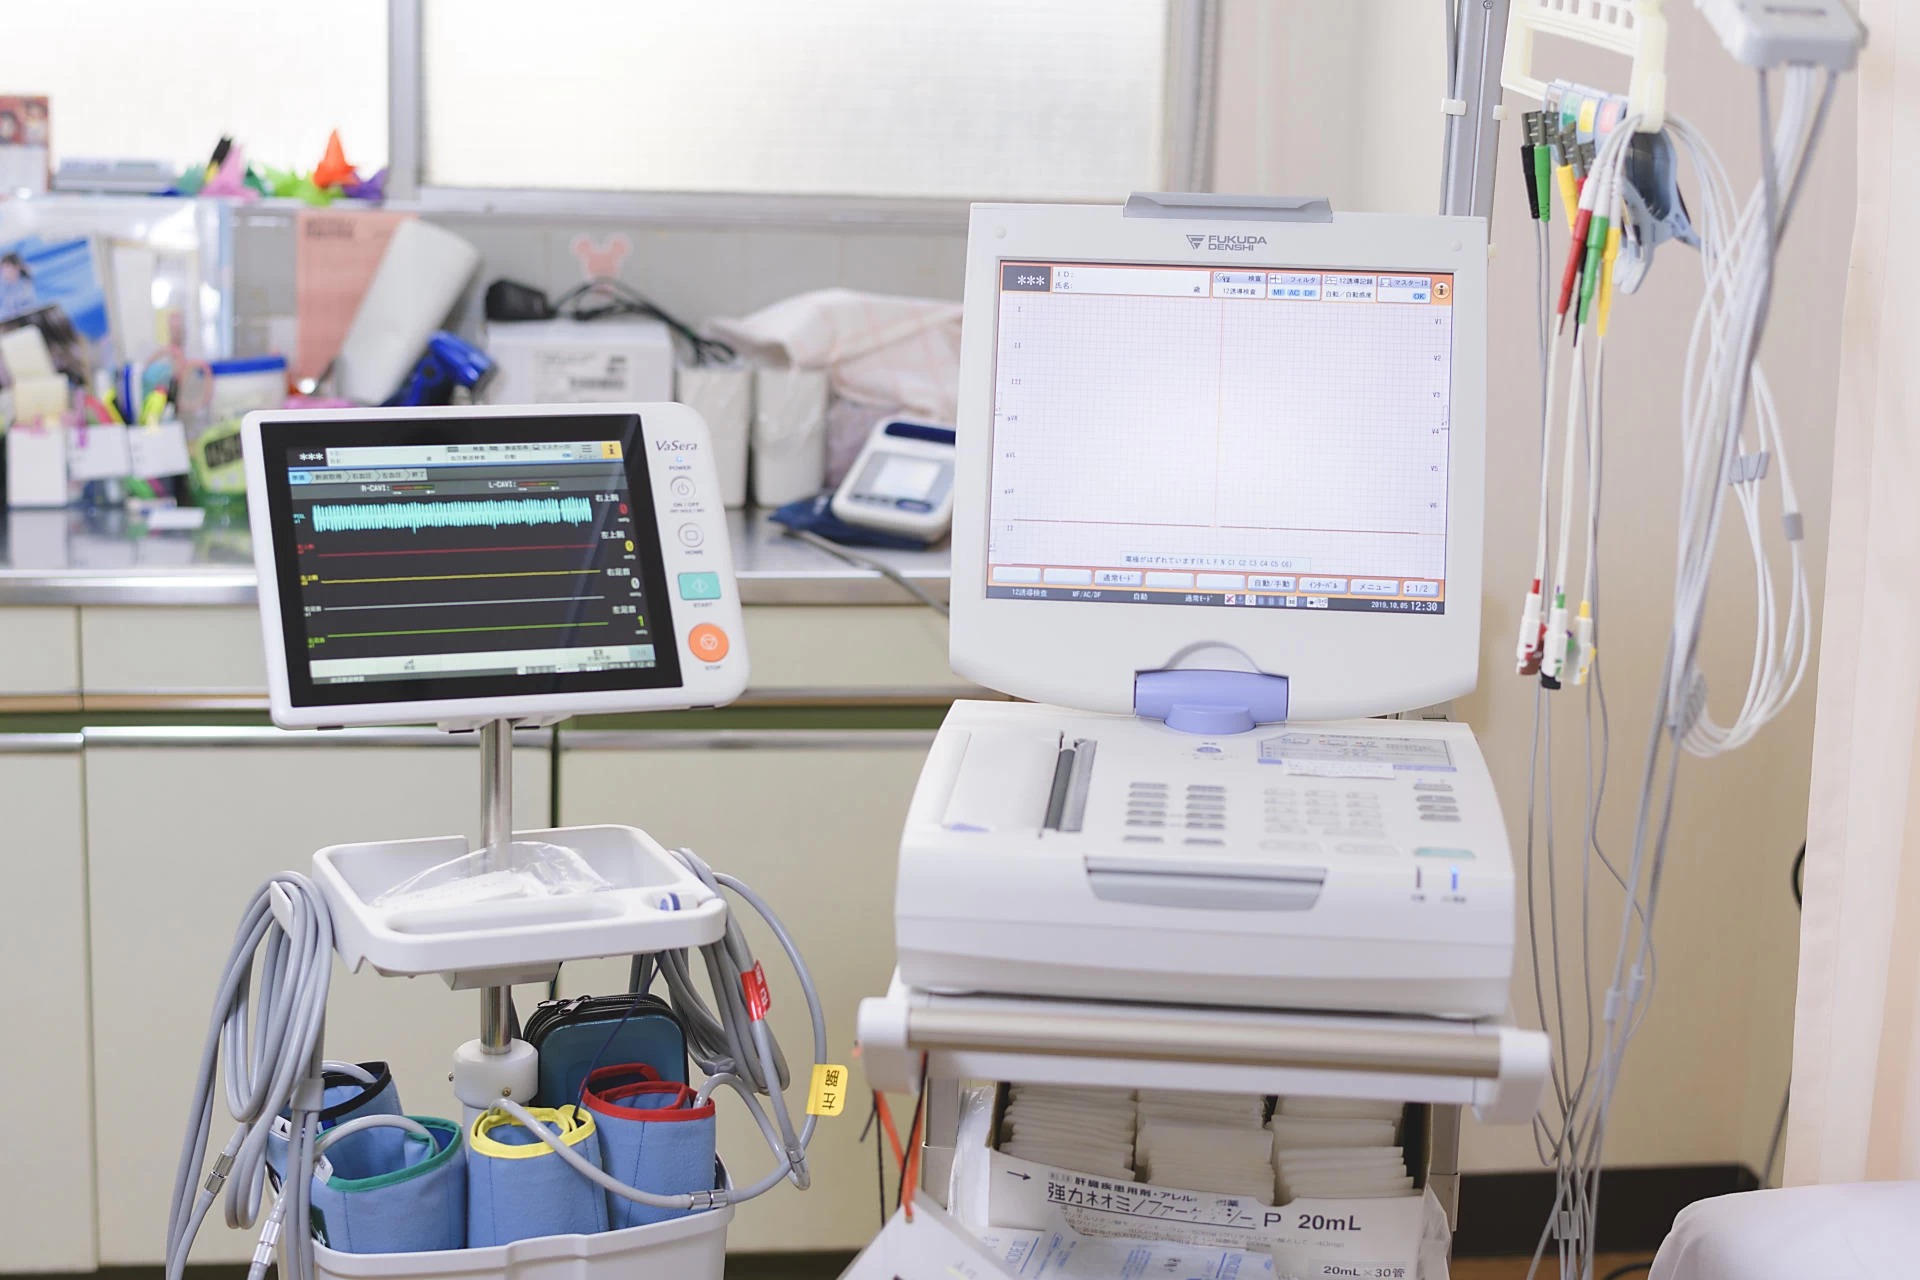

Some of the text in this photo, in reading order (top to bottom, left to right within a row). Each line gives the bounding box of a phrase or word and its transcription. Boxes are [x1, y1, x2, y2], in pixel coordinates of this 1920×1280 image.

[1208, 235, 1267, 245] FUKUDA
[1208, 243, 1254, 251] DENSHI
[1412, 292, 1426, 300] OK
[655, 439, 698, 452] VaSera
[625, 540, 635, 552] 0
[630, 577, 640, 589] 0
[1359, 584, 1393, 592] メニュー
[1413, 584, 1429, 593] 1/2
[1371, 601, 1438, 611] 2019.10.05 12:30
[637, 615, 645, 627] 1
[1263, 1212, 1282, 1228] P
[1298, 1214, 1362, 1231] 20mL
